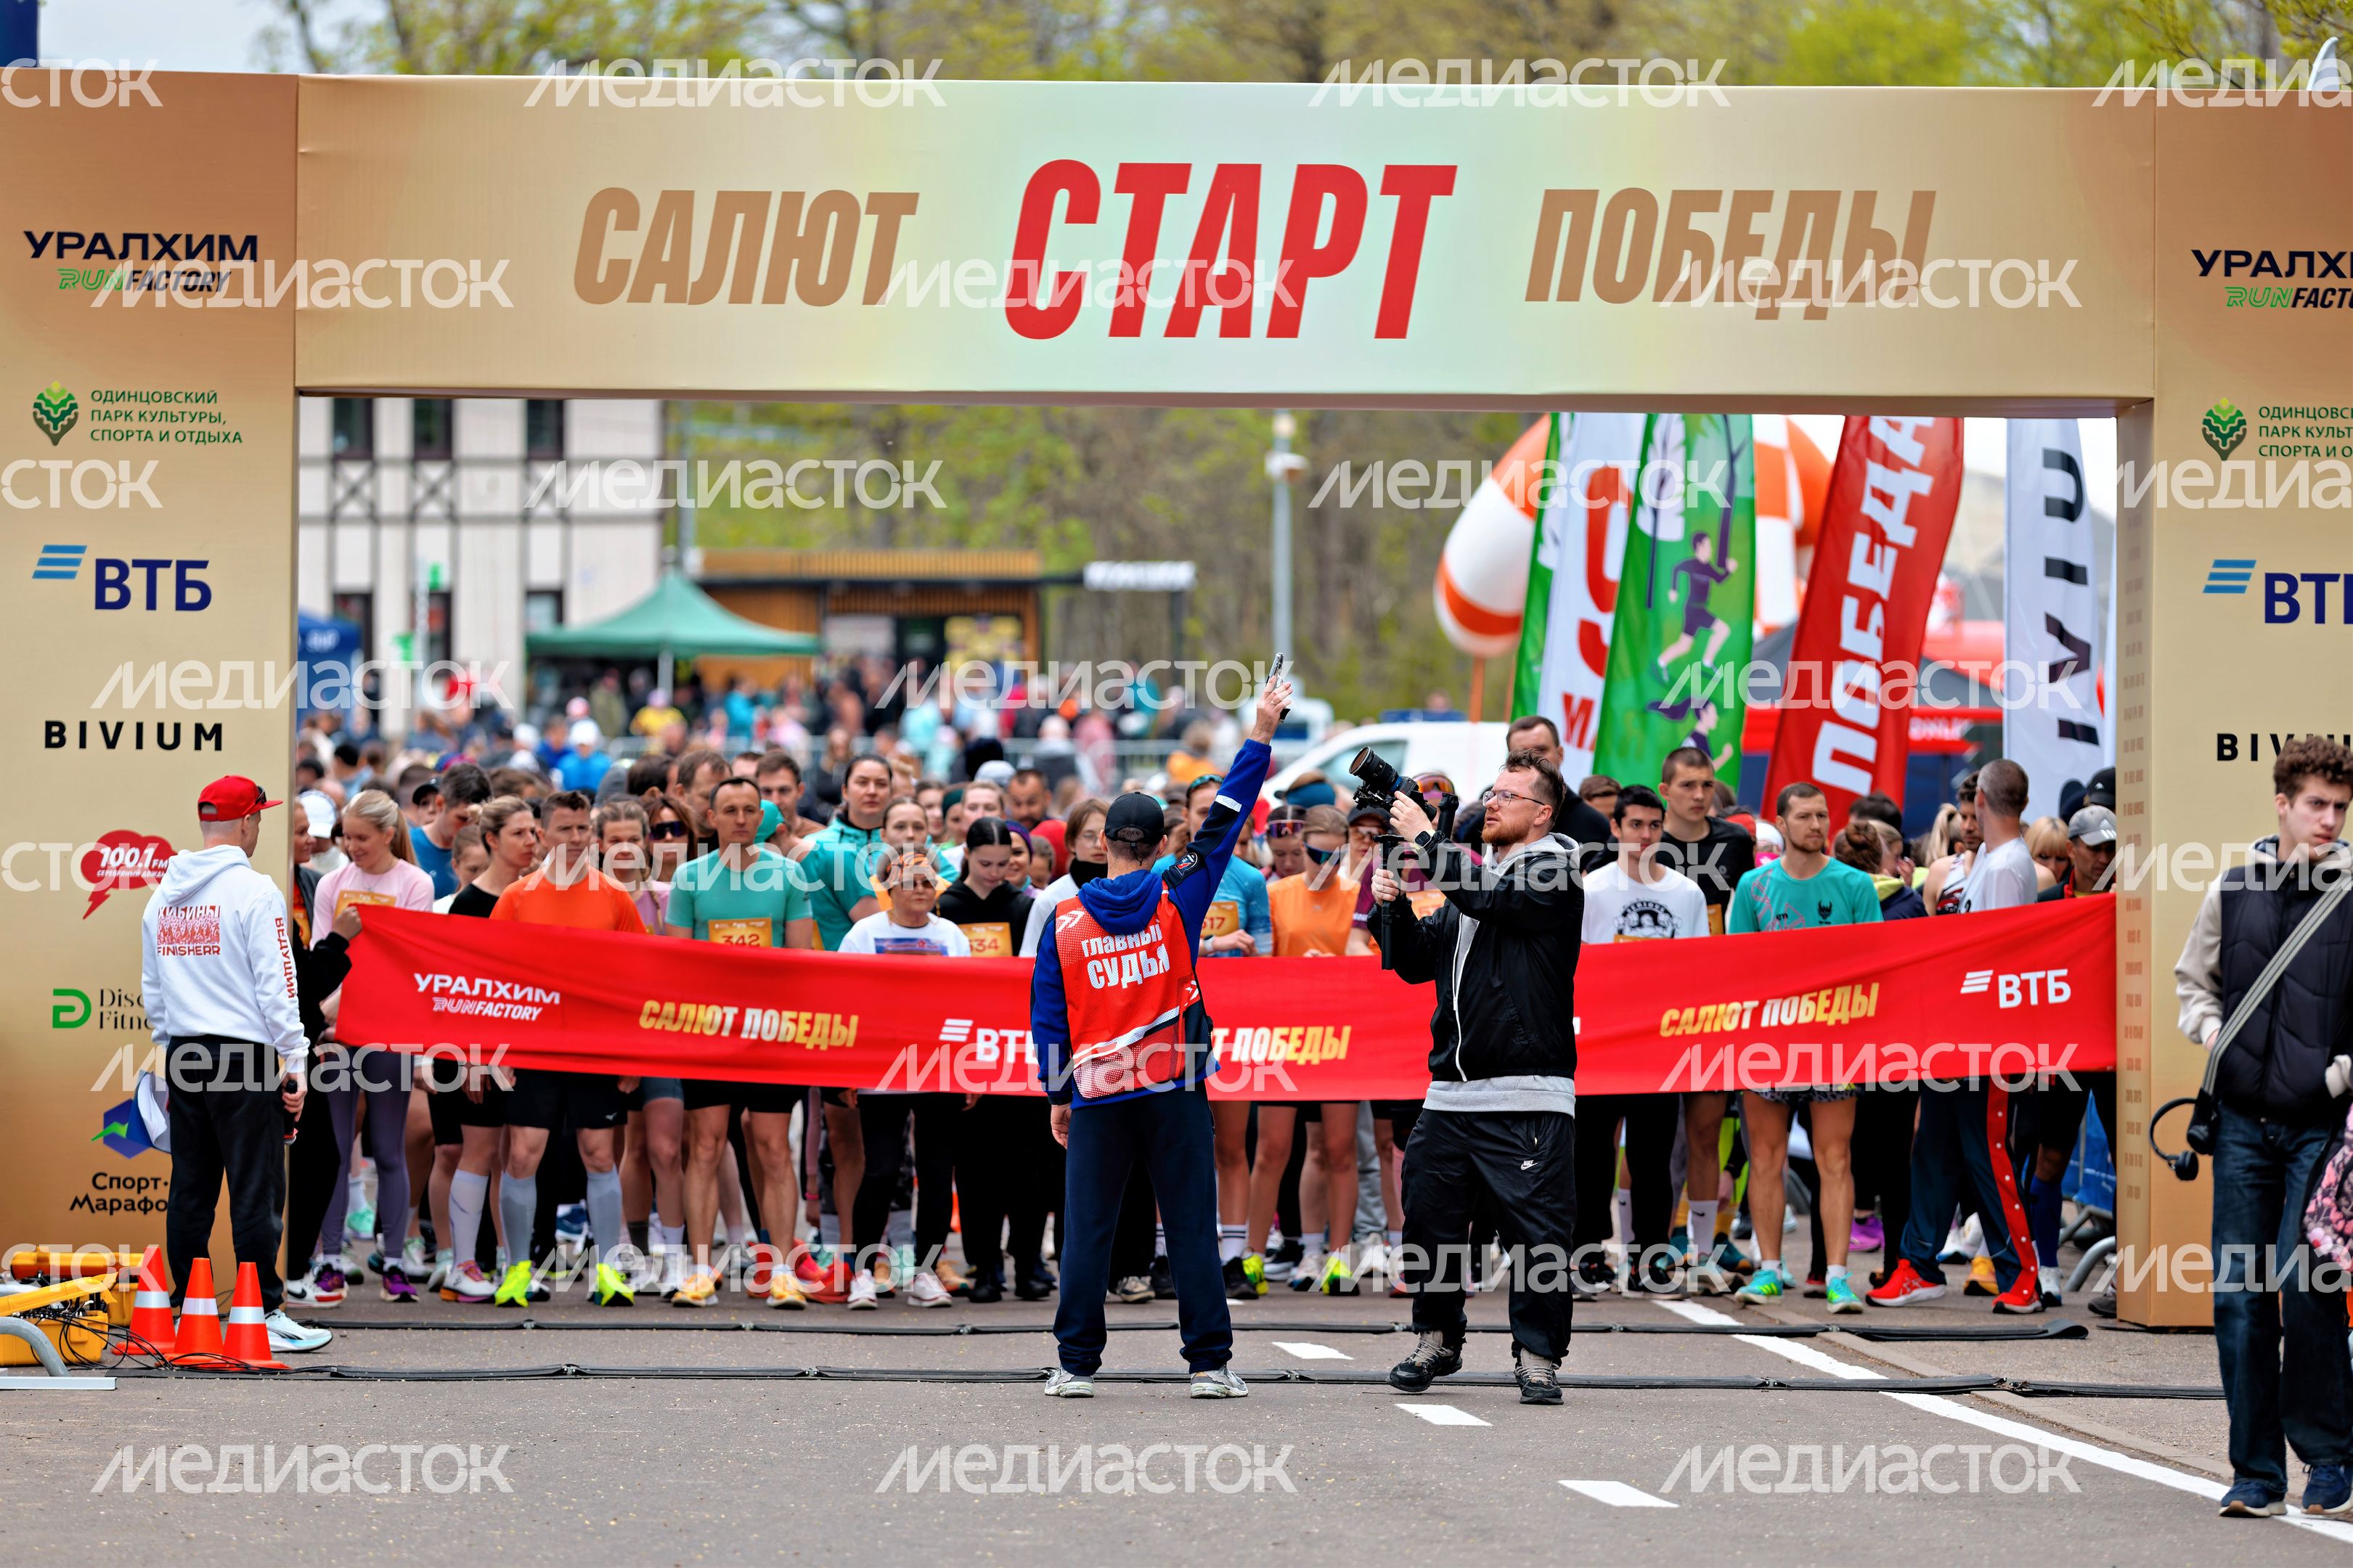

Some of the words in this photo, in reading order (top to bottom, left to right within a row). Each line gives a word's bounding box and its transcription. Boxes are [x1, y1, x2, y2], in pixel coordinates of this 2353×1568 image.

[24, 231, 258, 262] УРАЛХИМ
[574, 187, 919, 306] САЛЮТ
[1005, 159, 1458, 339] СТАРТ
[1525, 187, 1936, 320] ПОБЕДЫ
[91, 390, 218, 405] ОДИНЦОВСКИЙ
[91, 409, 134, 422] ПАРК
[139, 410, 227, 425] КУЛЬТУРЫ,
[2259, 407, 2353, 421] ОДИНЦОВС
[91, 429, 154, 441] СПОРТА
[159, 430, 169, 441] И
[175, 430, 242, 445] ОТДЫХА
[2259, 425, 2301, 438] ПАРК
[2259, 445, 2321, 457] СПОРТА
[2326, 446, 2336, 457] И
[95, 558, 212, 611] ВТБ
[44, 720, 223, 751] BIVIUM
[2217, 733, 2351, 761] BIV
[100, 846, 155, 868] 100.1
[152, 859, 168, 869] FM
[97, 868, 141, 878] СЕРЕБРЯНЫЙ
[157, 945, 221, 956] FINISHERR
[1087, 943, 1170, 989] СУДЬЯ
[414, 973, 560, 1005] УРАЛХИМ
[1998, 968, 2071, 1009] ВТБ
[1660, 1001, 1760, 1037] САЛЮТ
[1761, 982, 1880, 1027] ПОБЕДЫ
[639, 1000, 738, 1037] САЛЮТ
[741, 1007, 859, 1050] ПОБЕДЫ
[1231, 1025, 1352, 1065] ПОБЕДЫ
[69, 1193, 168, 1216] Марафо
